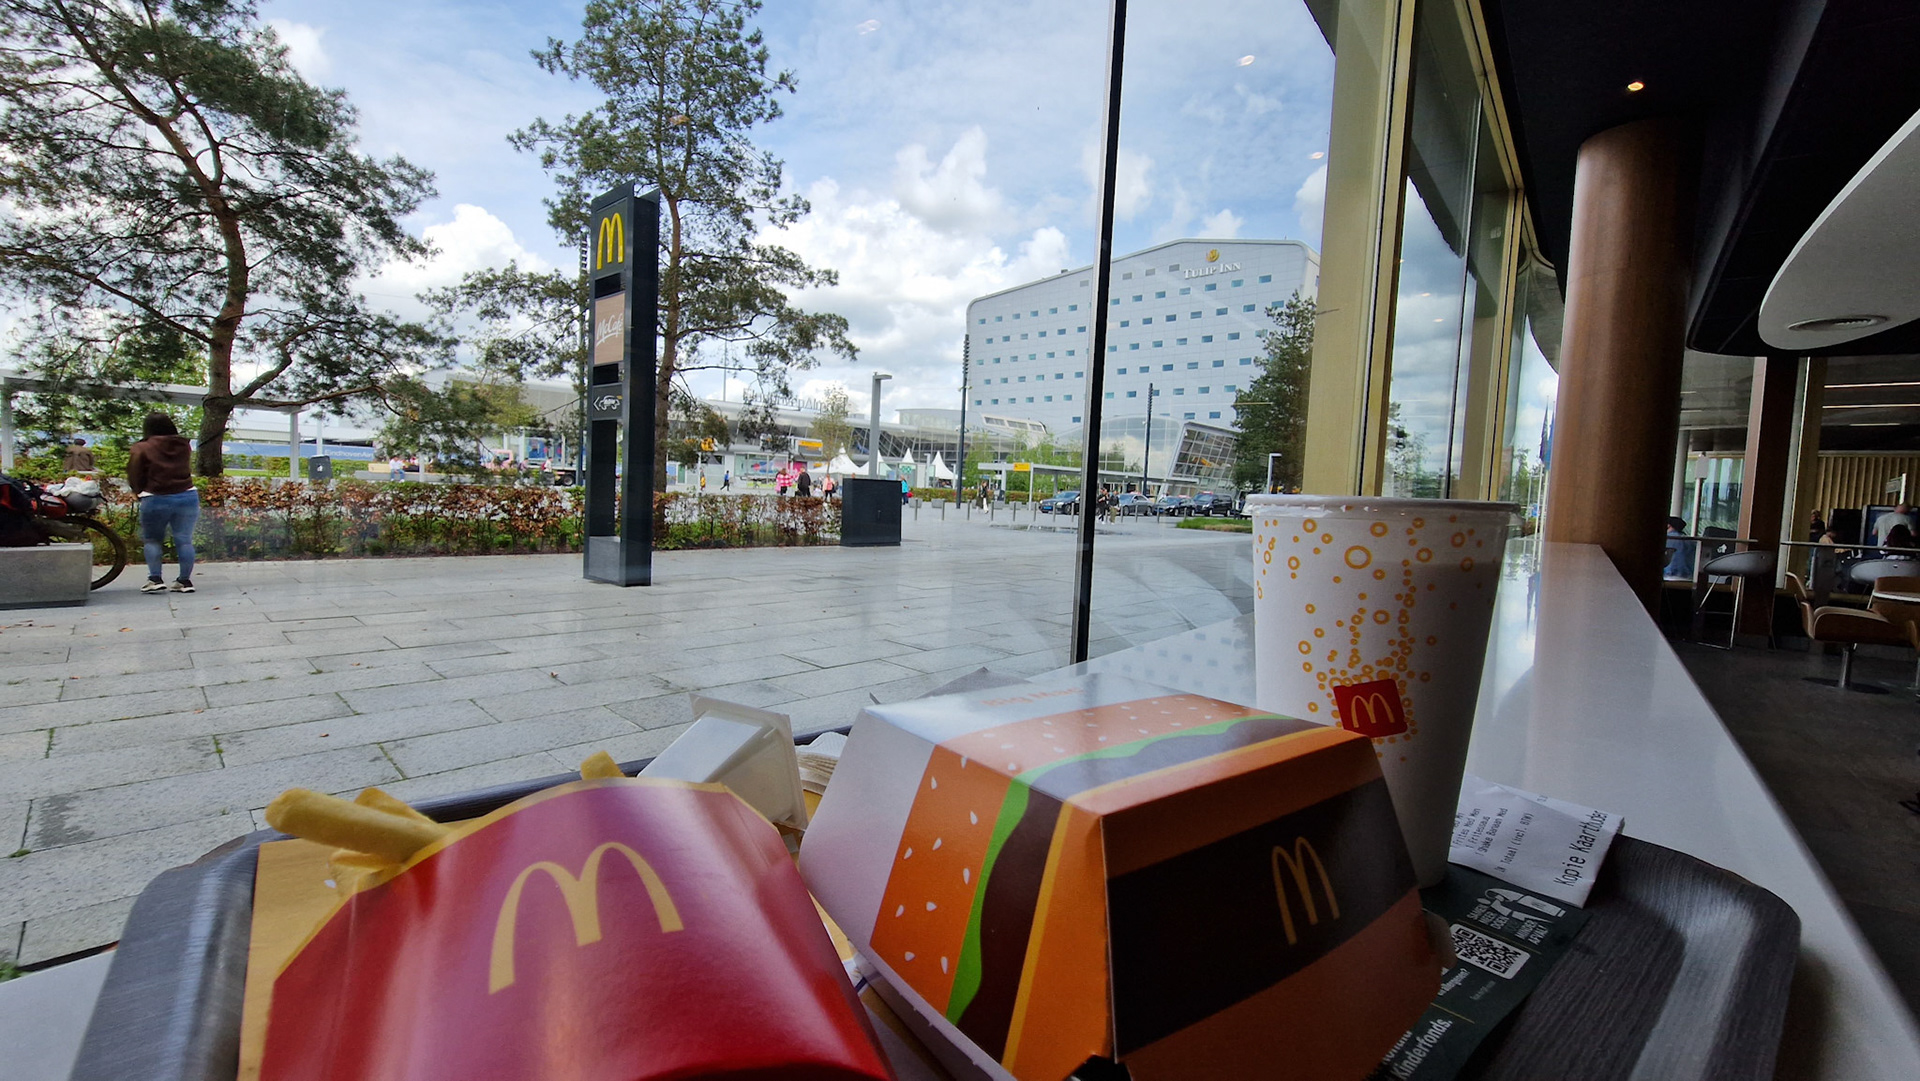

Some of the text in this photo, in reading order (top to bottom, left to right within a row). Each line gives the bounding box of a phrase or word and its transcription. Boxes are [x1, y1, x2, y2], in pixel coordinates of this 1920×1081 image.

[1184, 262, 1241, 280] TULIP INN
[1553, 854, 1587, 887] Kopie
[1393, 1018, 1453, 1080] Kinderfonds.
